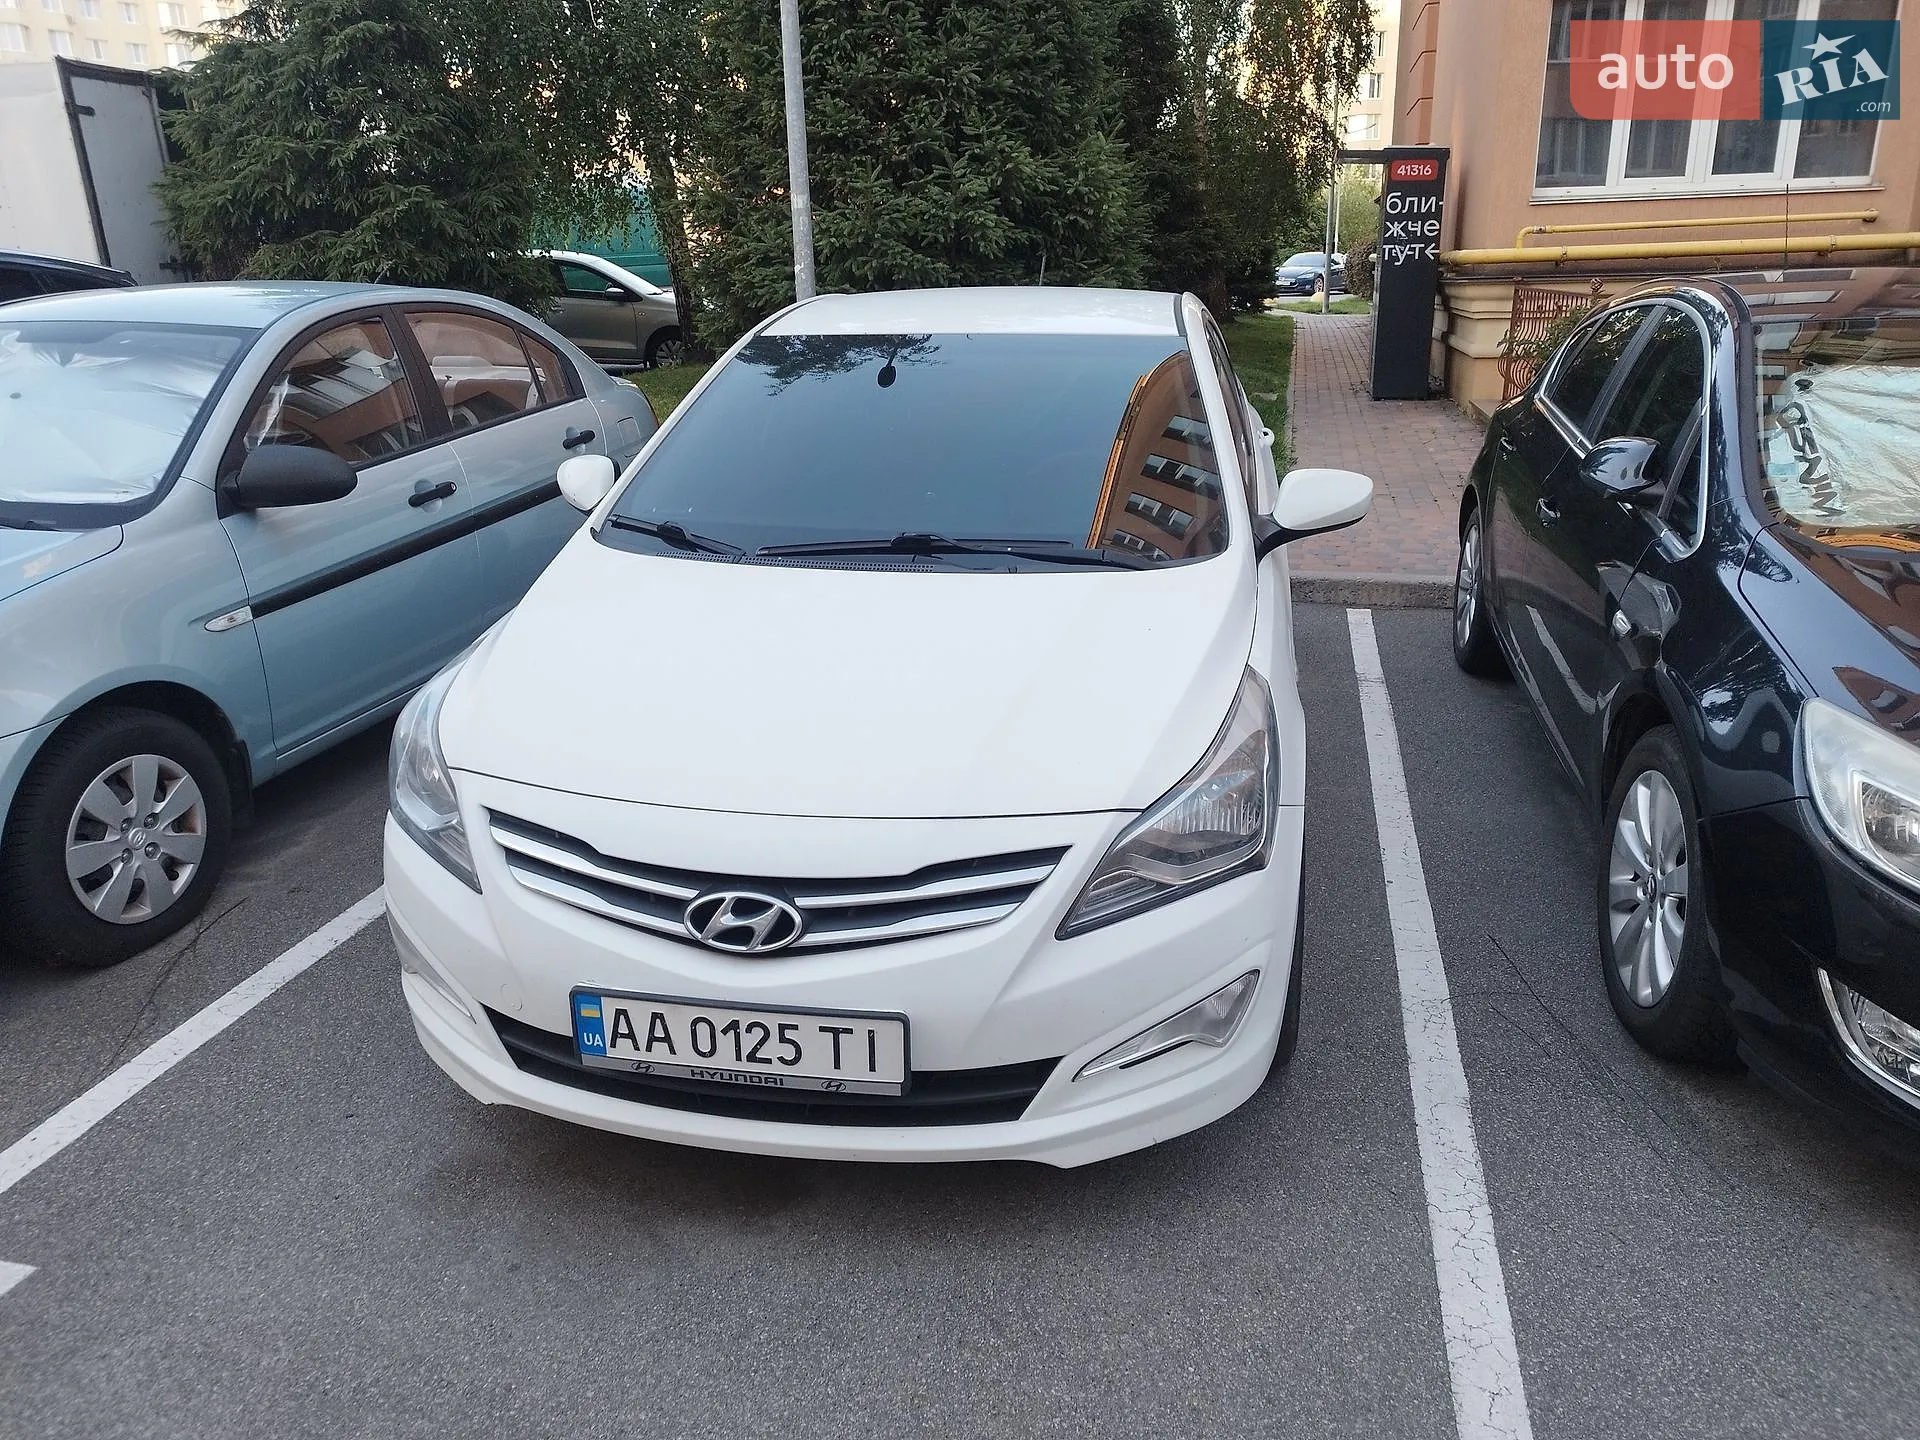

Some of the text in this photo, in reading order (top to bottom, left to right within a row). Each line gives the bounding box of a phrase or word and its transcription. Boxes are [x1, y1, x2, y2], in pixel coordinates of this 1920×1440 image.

[1397, 164, 1432, 176] 41316
[1384, 219, 1440, 238] жче
[583, 1032, 604, 1047] UA
[609, 1008, 878, 1073] AA 0125 TI
[690, 1068, 784, 1087] HYUNDAI
